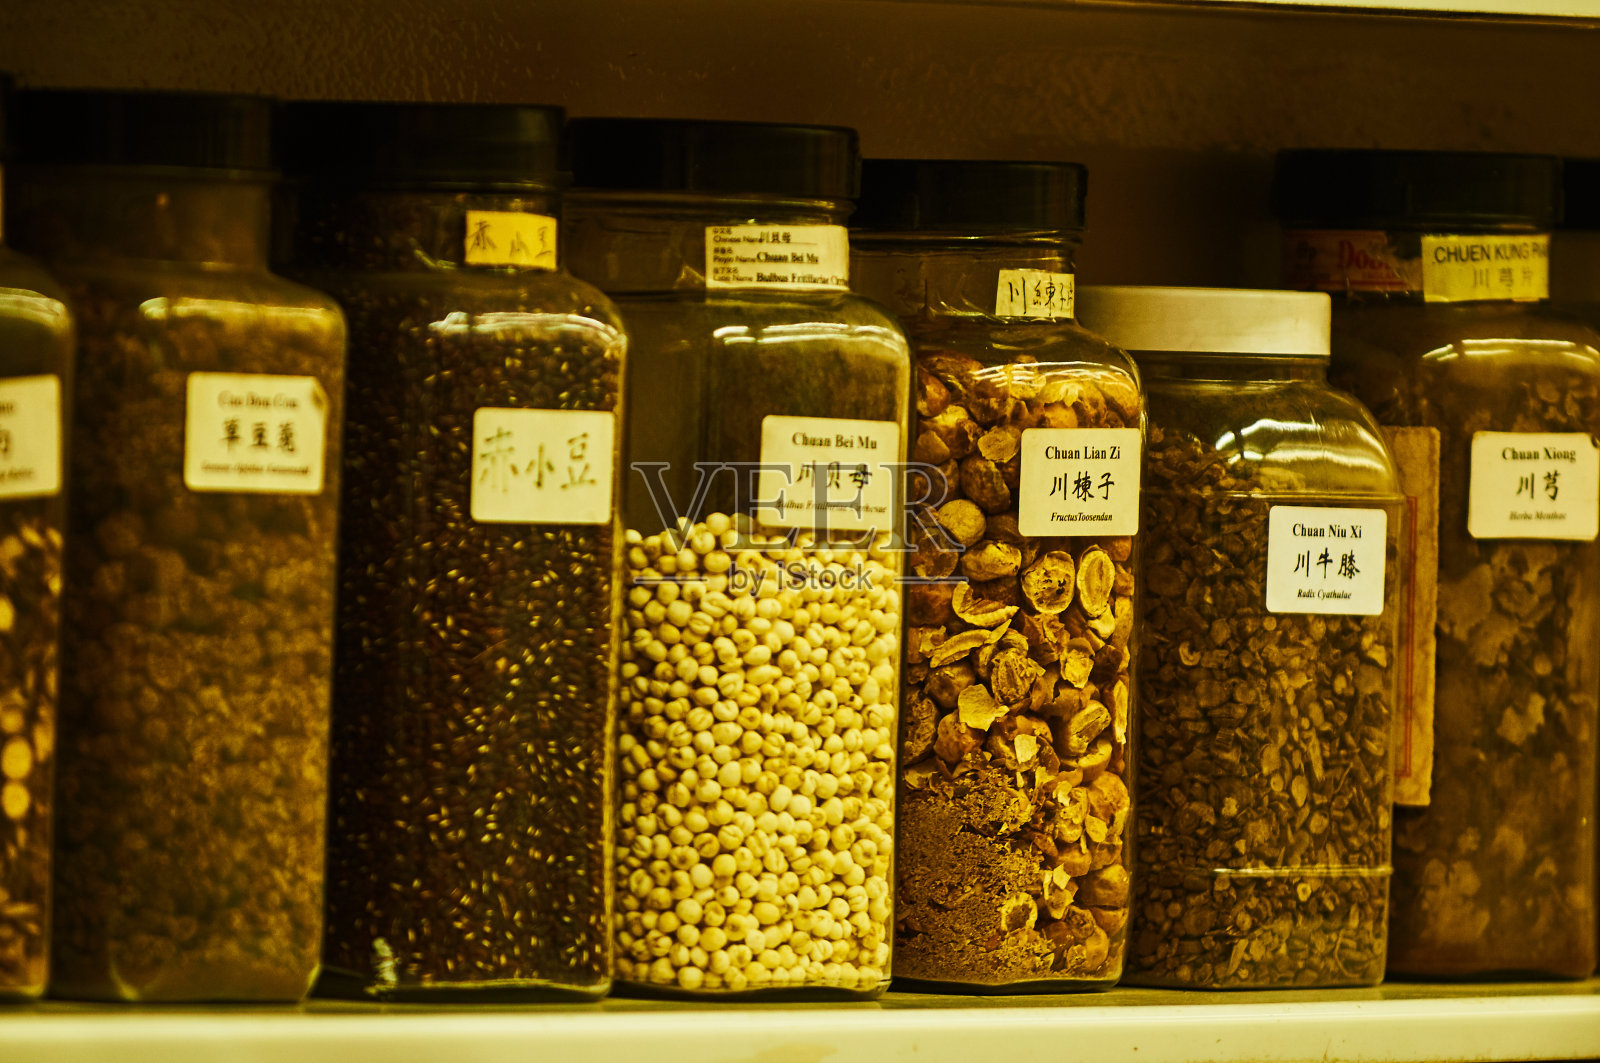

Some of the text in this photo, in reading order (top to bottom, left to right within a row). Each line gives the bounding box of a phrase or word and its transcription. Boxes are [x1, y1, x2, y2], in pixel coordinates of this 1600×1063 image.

[757, 252, 788, 263] Chuan
[791, 252, 804, 264] Bei
[1434, 245, 1490, 264] CHUEN
[1495, 243, 1529, 260] KUNG
[791, 432, 878, 450] Chuan Bei Mu
[479, 427, 597, 492] 赤小豆
[1045, 446, 1121, 460] Chuan Lian Zi
[1501, 447, 1576, 462] Chuan Xiong
[1516, 470, 1561, 501] 川芎
[1292, 523, 1362, 539] Chuan Niu Xi
[1294, 547, 1360, 579] 川牛膝
[1297, 588, 1352, 600] Radix Cyathulae
